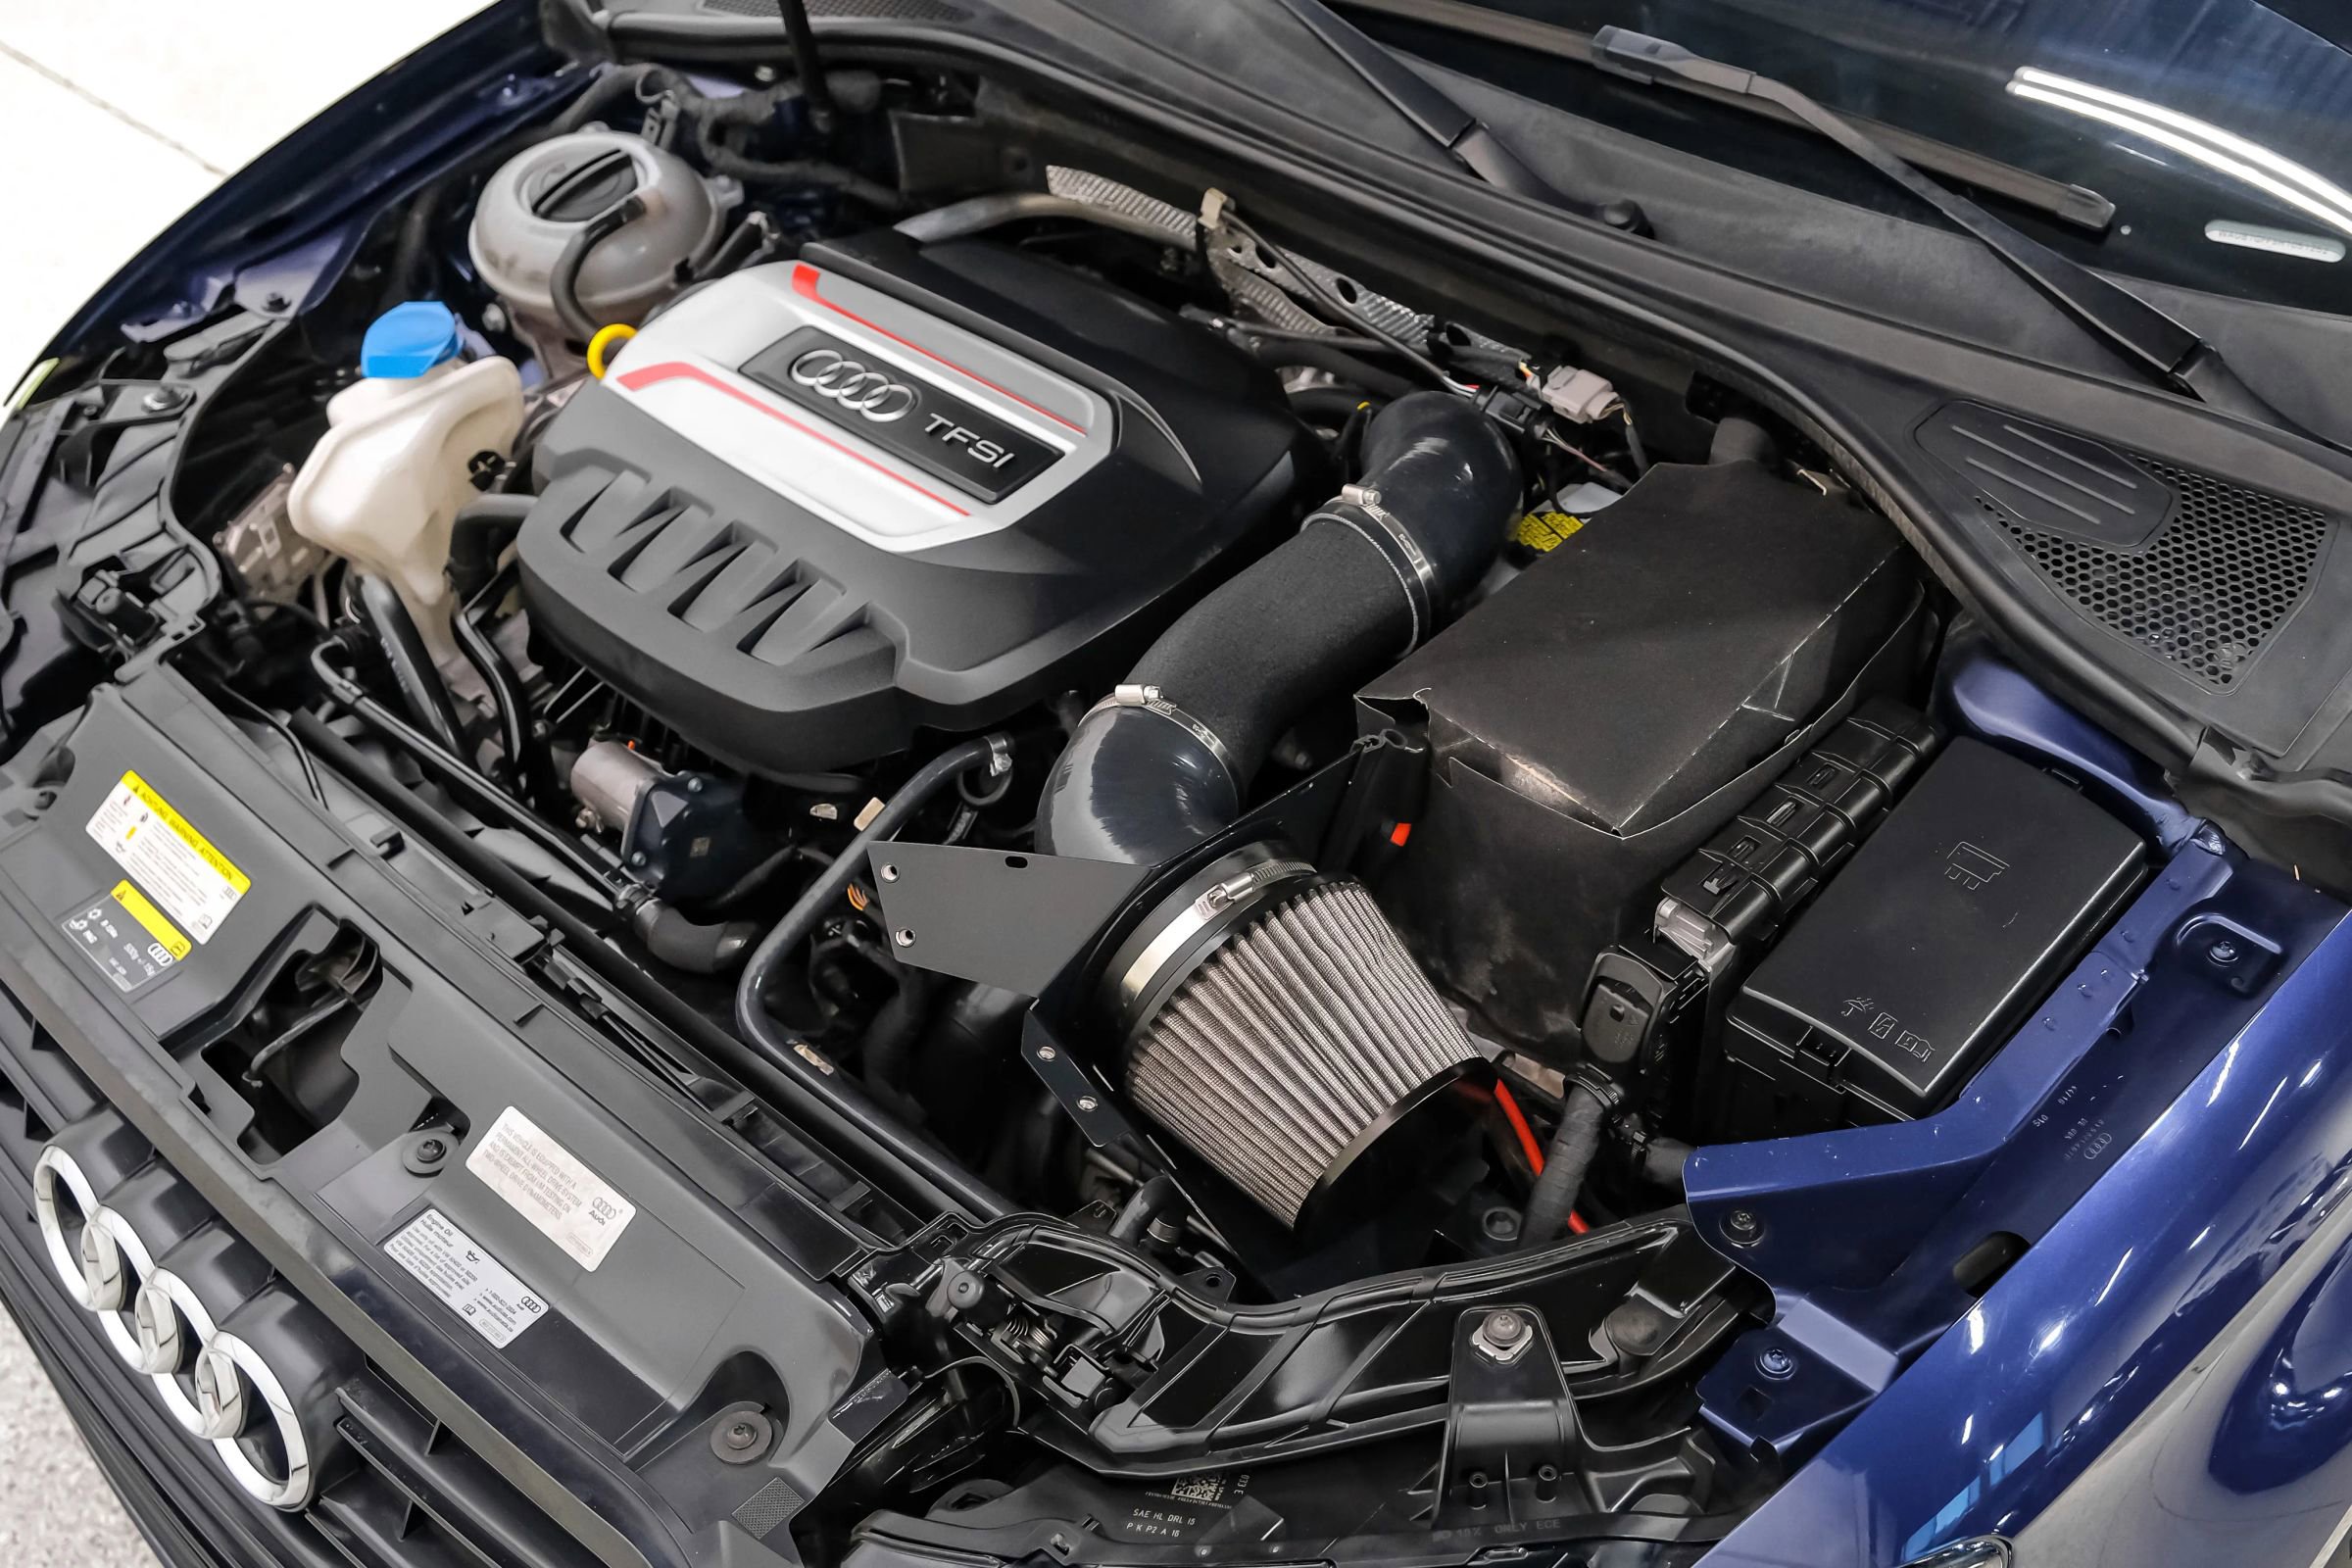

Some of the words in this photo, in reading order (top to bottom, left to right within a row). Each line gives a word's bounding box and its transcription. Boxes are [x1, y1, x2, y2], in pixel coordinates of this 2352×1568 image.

[924, 413, 1016, 469] TFSI
[169, 818, 199, 848] WARNING
[199, 848, 233, 880] ATTENTION
[509, 1172, 523, 1187] DRIVE
[536, 1152, 560, 1174] EQUIPPED
[559, 1170, 573, 1185] WITH
[570, 1179, 578, 1189] A
[521, 1168, 536, 1183] FROM
[543, 1187, 564, 1205] TESTING
[562, 1201, 572, 1213] ON
[561, 1188, 581, 1206] SYSTEM
[426, 1214, 445, 1230] Engine
[443, 1228, 453, 1237] Oil
[588, 1208, 606, 1225] Audi
[419, 1219, 433, 1231] Huile
[432, 1231, 453, 1248] moteur
[1133, 1508, 1152, 1519] SAE
[1152, 1510, 1164, 1521] HL
[1167, 1513, 1184, 1524] DRL
[1494, 1522, 1528, 1533] ONLY
[1536, 1519, 1560, 1530] ECE
[1136, 1523, 1143, 1532] K
[1145, 1525, 1157, 1534] P2
[1160, 1527, 1167, 1536] A
